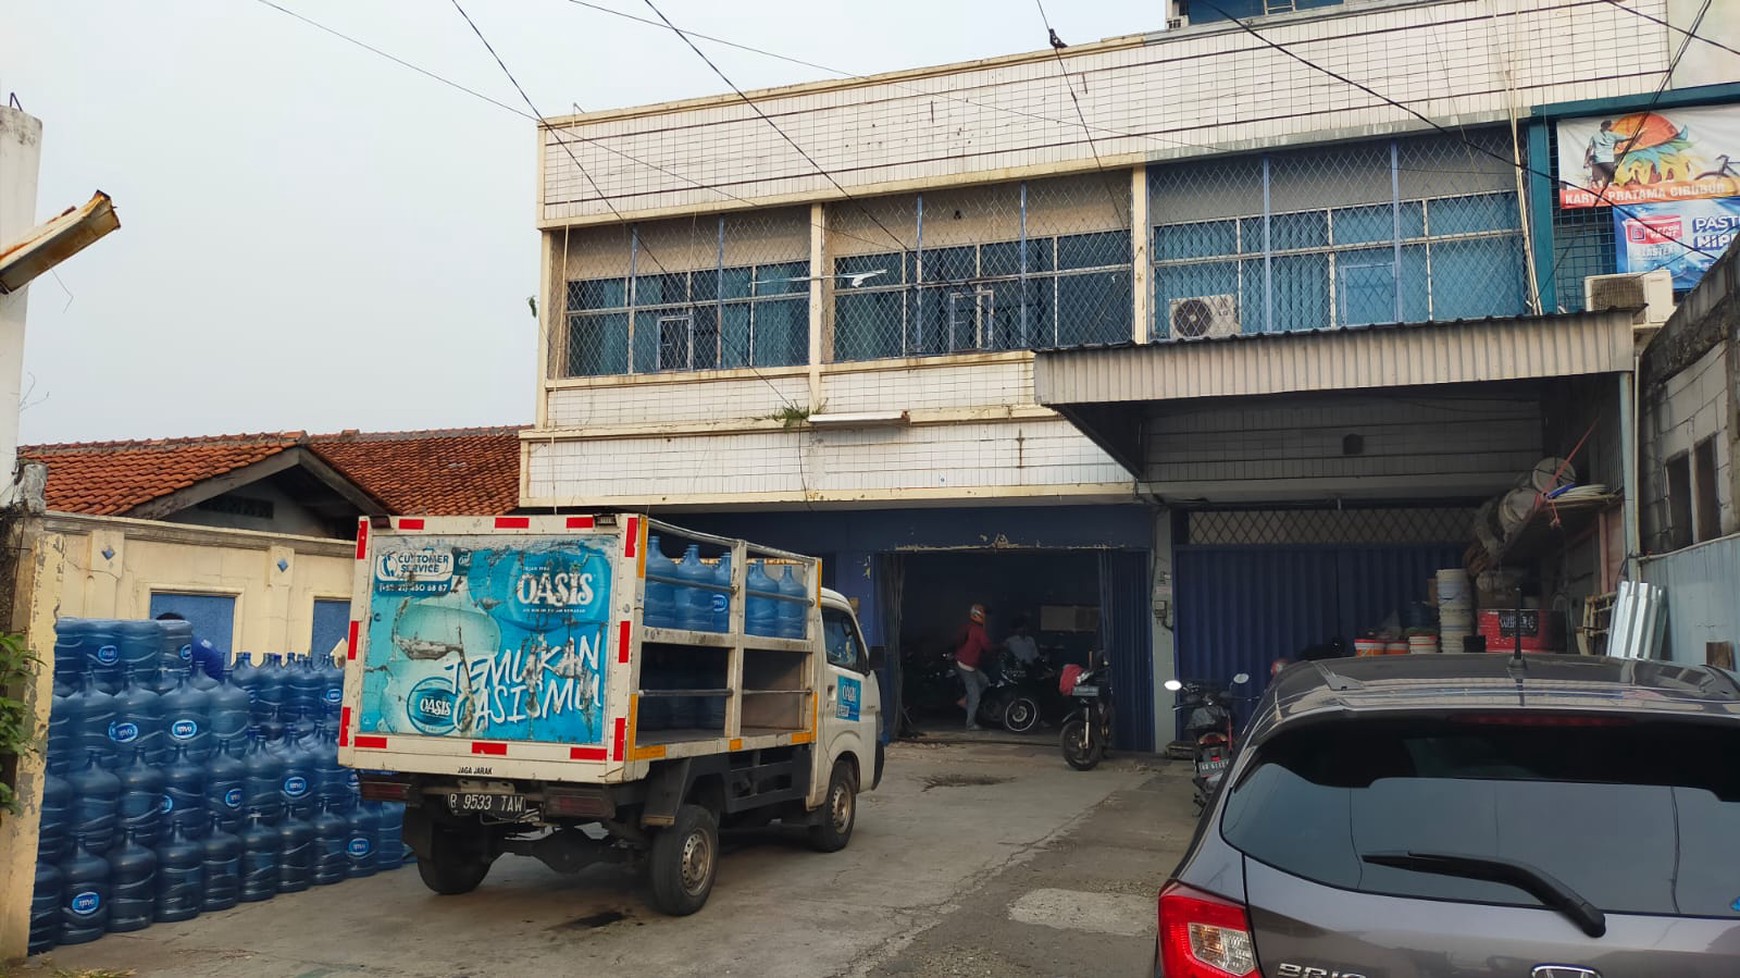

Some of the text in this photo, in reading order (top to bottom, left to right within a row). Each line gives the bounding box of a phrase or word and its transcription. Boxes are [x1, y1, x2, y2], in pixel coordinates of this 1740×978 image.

[1608, 188, 1665, 201] PRATAMA
[1695, 215, 1740, 230] PAST
[398, 554, 449, 564] CUTOMER
[517, 572, 593, 607] OASIS
[420, 697, 451, 716] OASIS
[458, 766, 493, 775] JAGA JARAK
[450, 793, 457, 808] B
[463, 794, 492, 810] 9533
